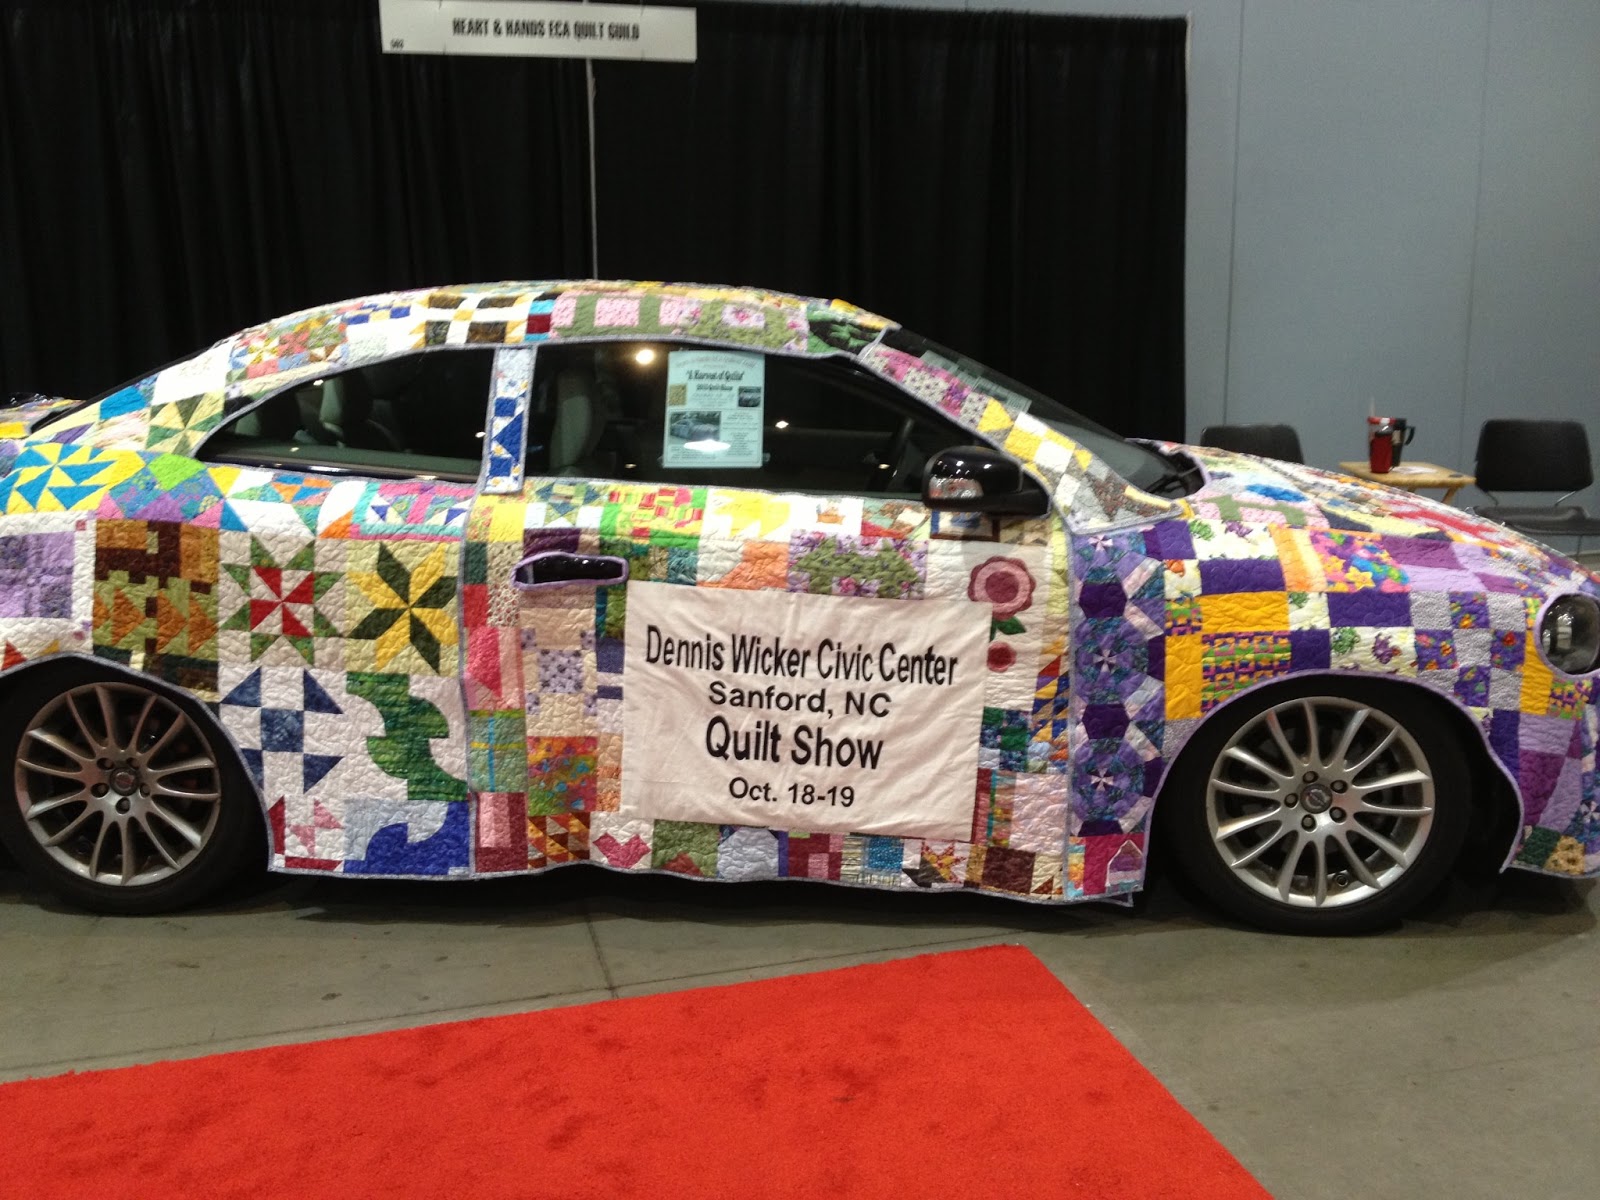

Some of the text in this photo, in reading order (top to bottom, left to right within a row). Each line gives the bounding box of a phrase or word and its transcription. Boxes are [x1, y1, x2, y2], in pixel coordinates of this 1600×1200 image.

[452, 18, 639, 41] HEART & HANDS ECA QUILT GUILD
[645, 624, 959, 686] Dennis Wicker Civic Center
[708, 680, 892, 719] Sanford, NC
[705, 715, 884, 770] Quilt Show
[728, 776, 856, 807] Oct. 18-19
